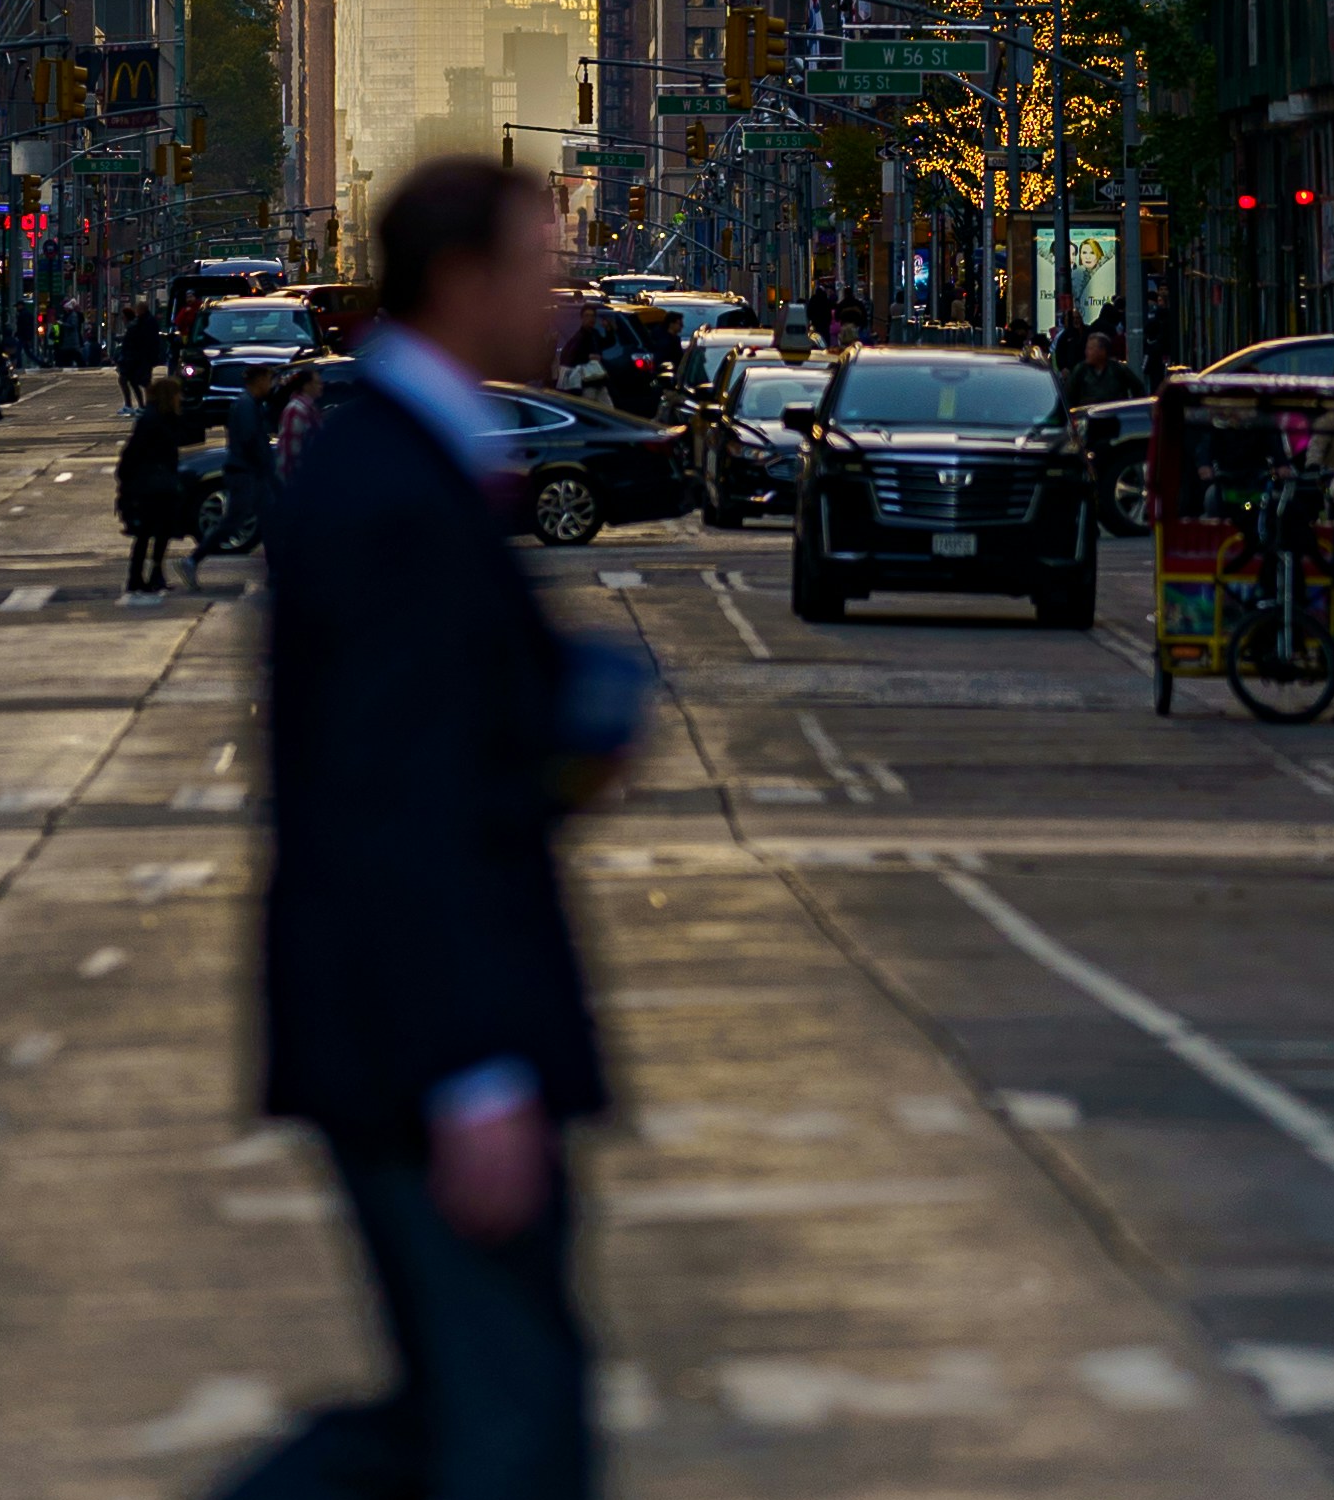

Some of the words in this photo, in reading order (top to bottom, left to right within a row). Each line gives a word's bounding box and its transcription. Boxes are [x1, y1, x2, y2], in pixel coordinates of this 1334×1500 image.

[882, 47, 897, 66] W
[903, 47, 923, 66] 56
[930, 47, 949, 67] St
[837, 74, 849, 90] W
[853, 74, 871, 91] 55
[875, 74, 891, 91] St
[682, 100, 692, 112] W
[695, 100, 711, 112] 54
[714, 100, 727, 113] St
[764, 136, 773, 147] W
[775, 136, 789, 147] 53
[791, 135, 802, 147] St
[99, 161, 111, 171] 52
[594, 154, 604, 165] W
[605, 154, 616, 165] 52
[619, 154, 628, 166] St
